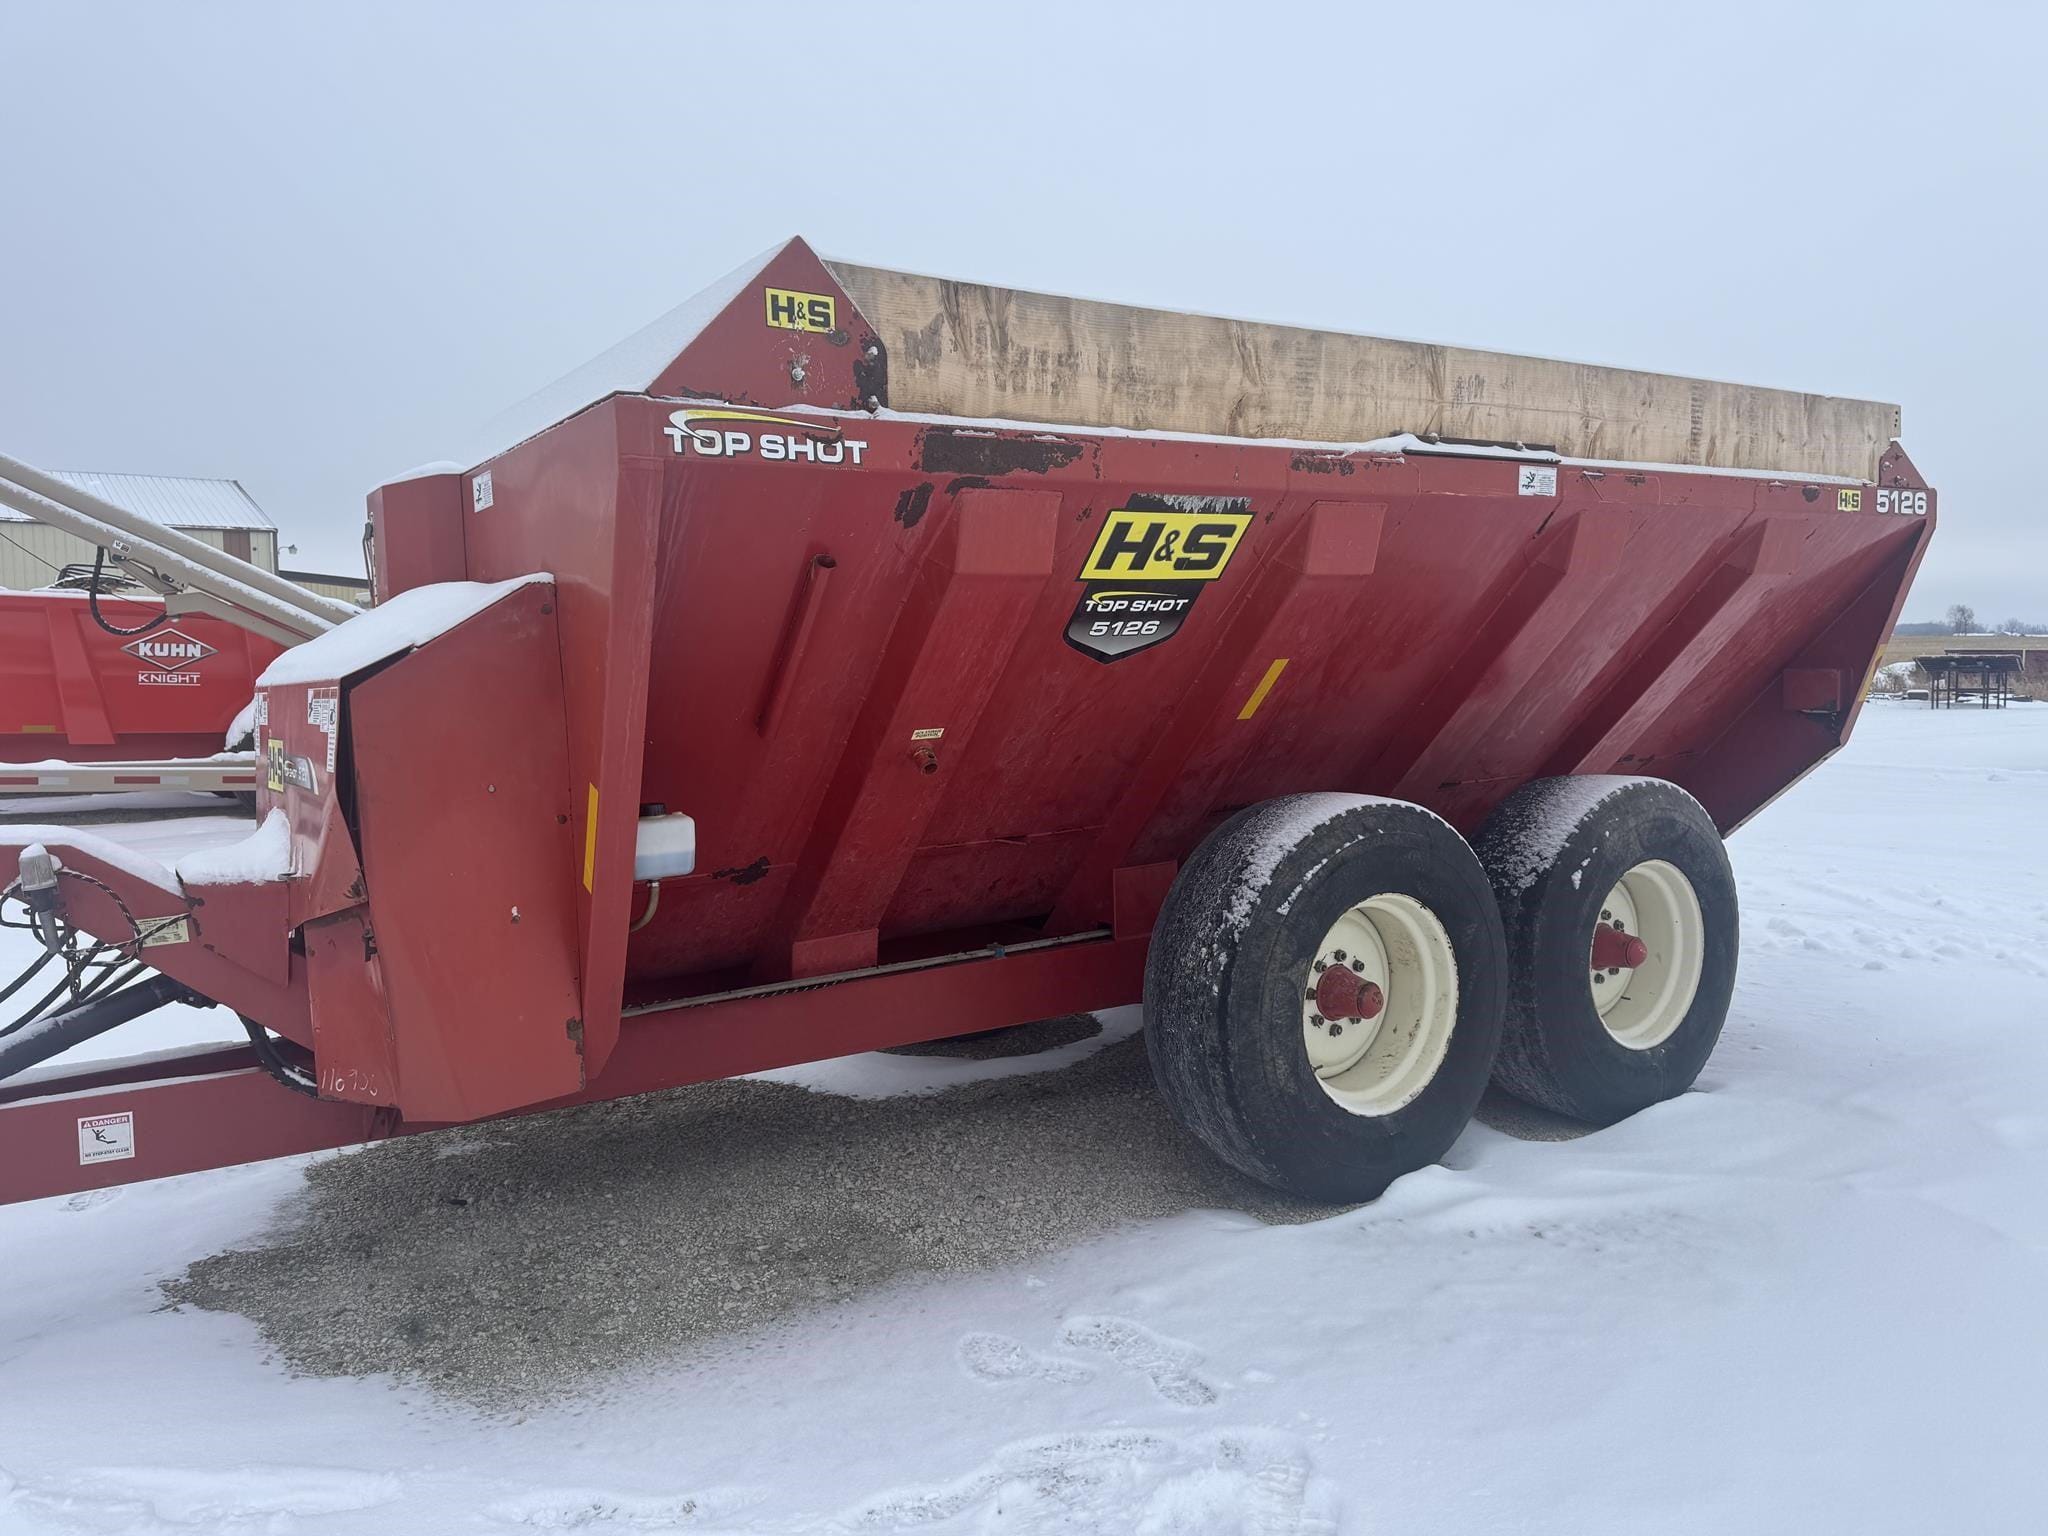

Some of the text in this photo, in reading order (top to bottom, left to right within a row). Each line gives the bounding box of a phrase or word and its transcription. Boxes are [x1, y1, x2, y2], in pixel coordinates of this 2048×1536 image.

[770, 293, 831, 329] H&S
[663, 425, 868, 465] TOP SHOT
[1876, 489, 1927, 514] 5126
[1093, 521, 1238, 571] H&S
[1085, 599, 1189, 613] TOP SHOT
[1089, 620, 1160, 637] 5126
[138, 642, 202, 657] KUHN
[138, 673, 201, 683] KNIGHT
[92, 1117, 128, 1127] DANGER
